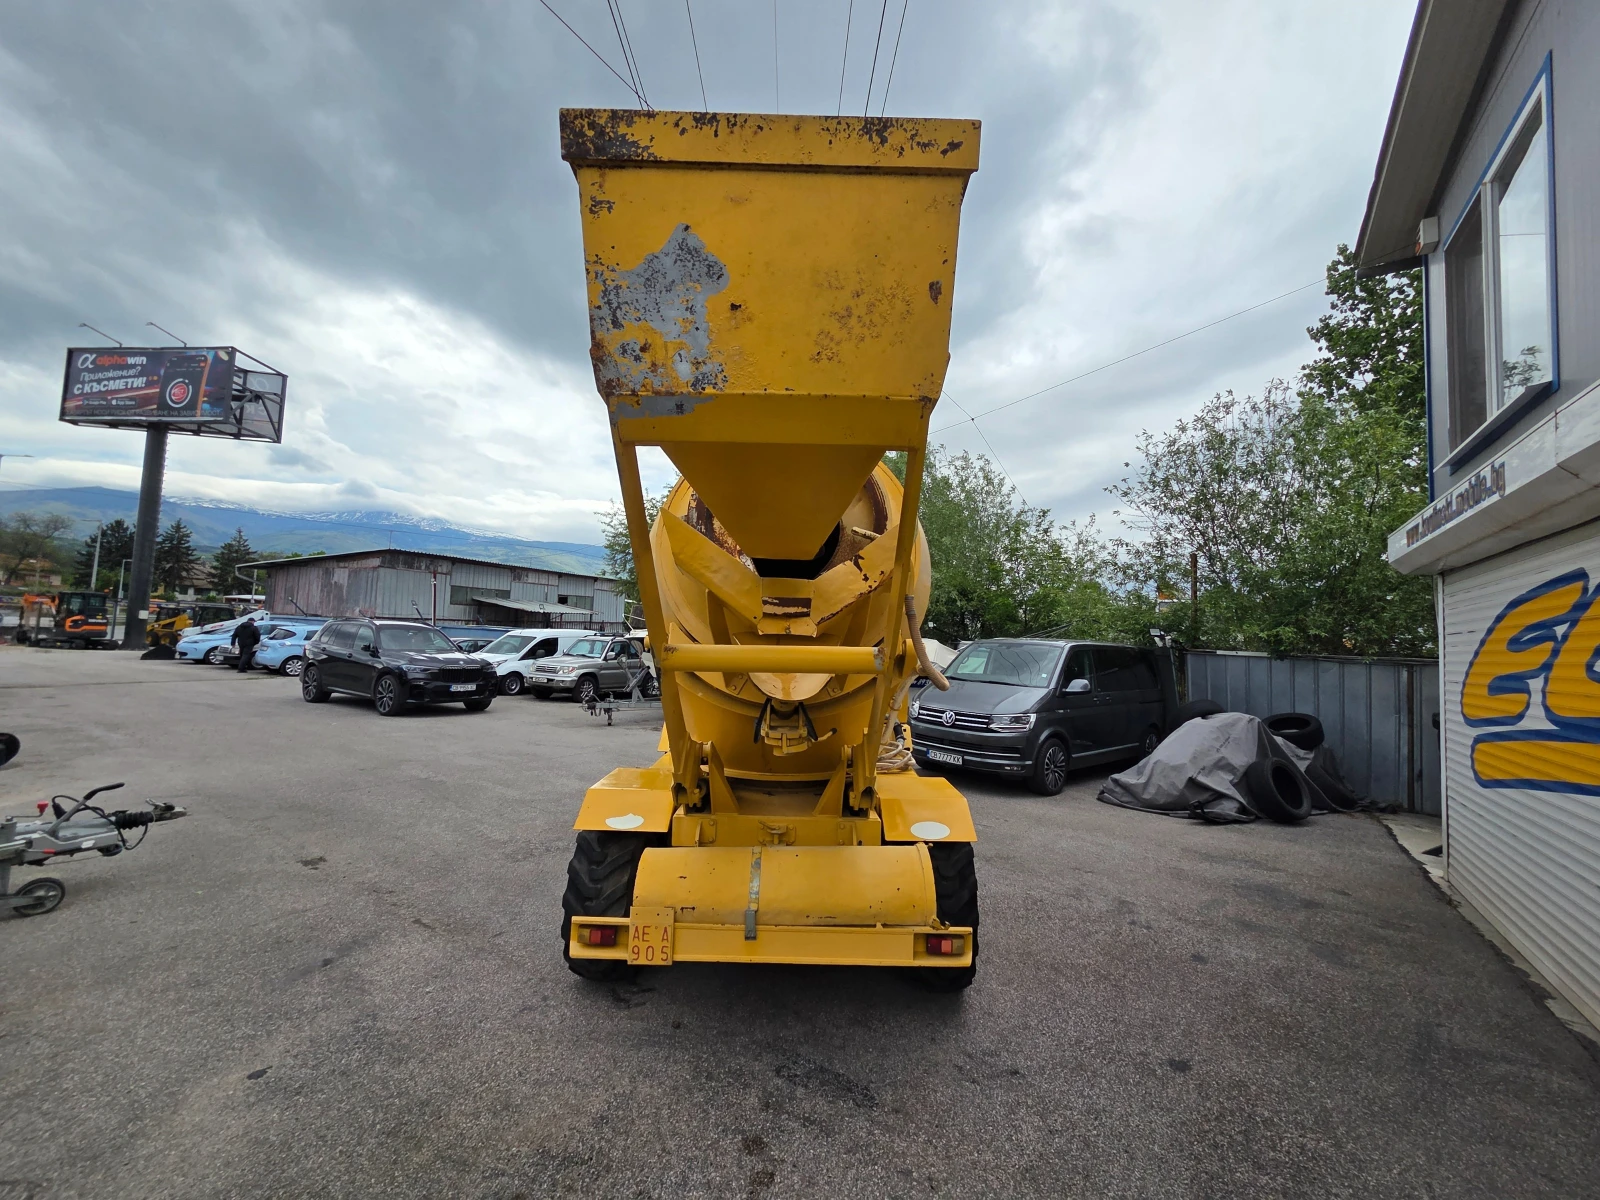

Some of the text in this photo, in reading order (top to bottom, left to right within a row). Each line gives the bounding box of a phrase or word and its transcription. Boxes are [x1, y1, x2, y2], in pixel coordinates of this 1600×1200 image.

[96, 355, 147, 366] alphawin
[80, 366, 142, 382] Приложение?
[83, 377, 147, 394] КЪСМЕТИ!
[632, 925, 669, 943] AE A
[631, 944, 669, 962] 905
